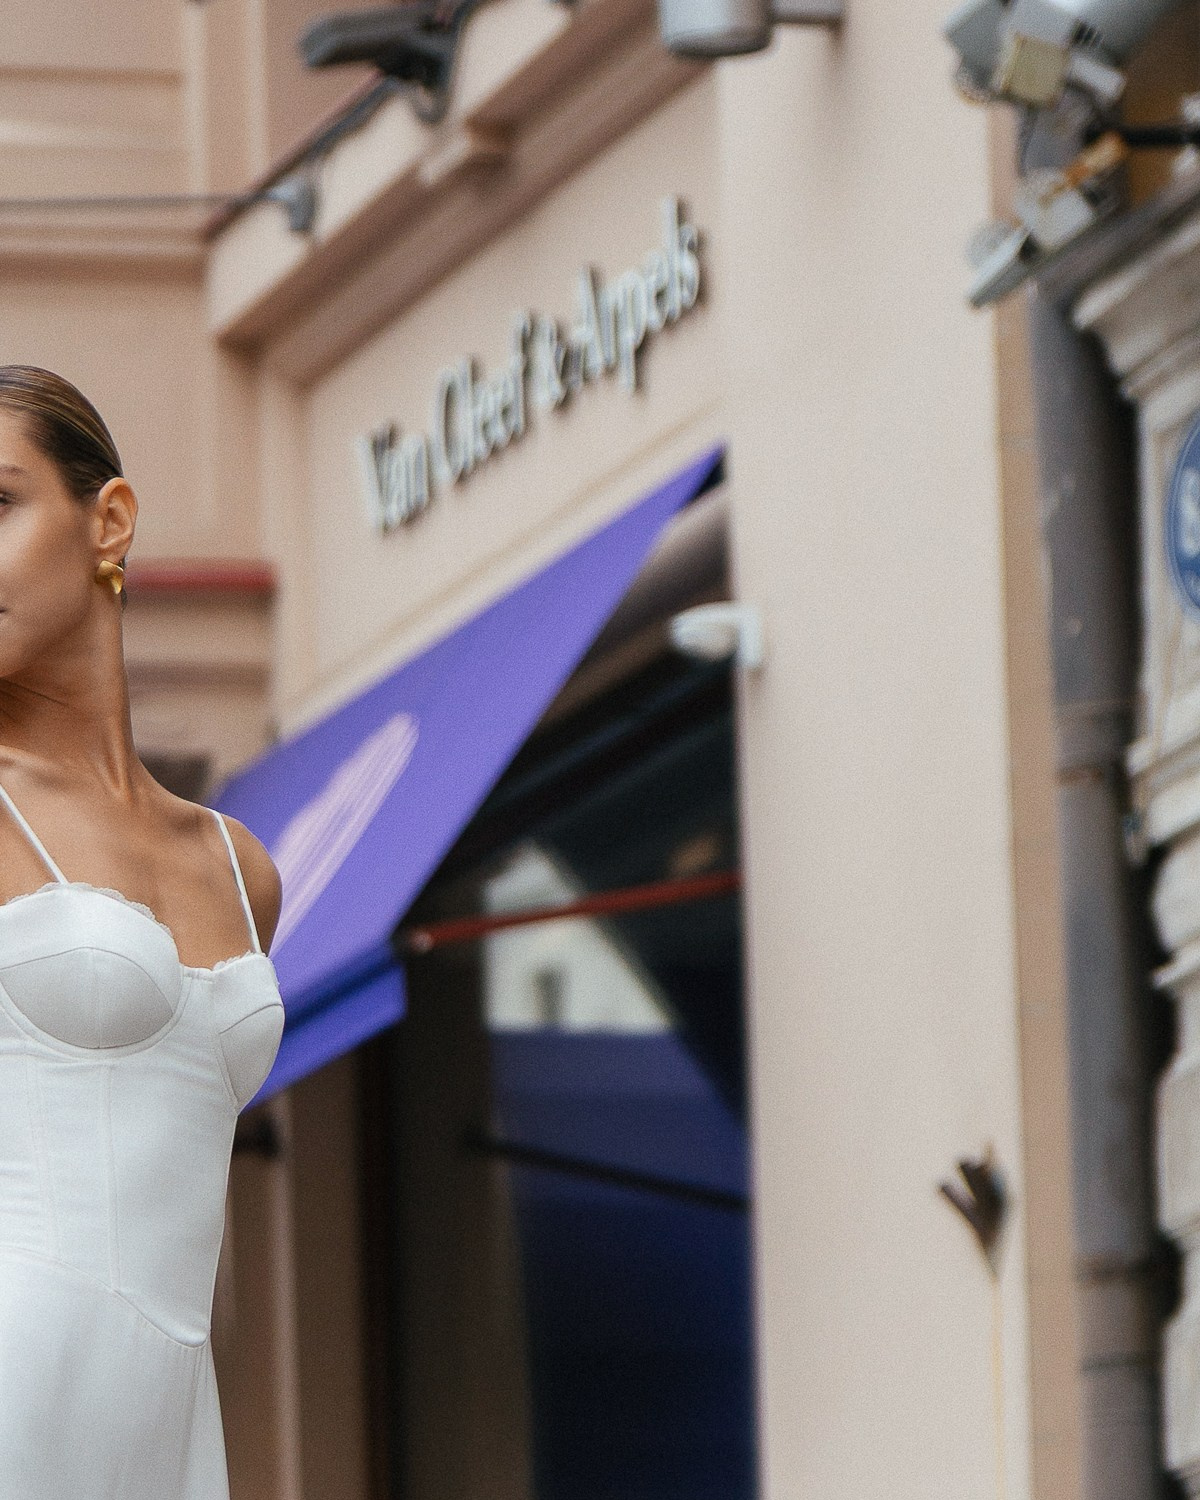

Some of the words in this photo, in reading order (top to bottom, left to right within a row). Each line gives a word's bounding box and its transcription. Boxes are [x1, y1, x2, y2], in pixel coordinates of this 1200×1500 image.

[356, 422, 429, 530] Van
[429, 314, 528, 484] Cleef
[532, 317, 565, 409] &
[569, 195, 701, 394] Arpels
